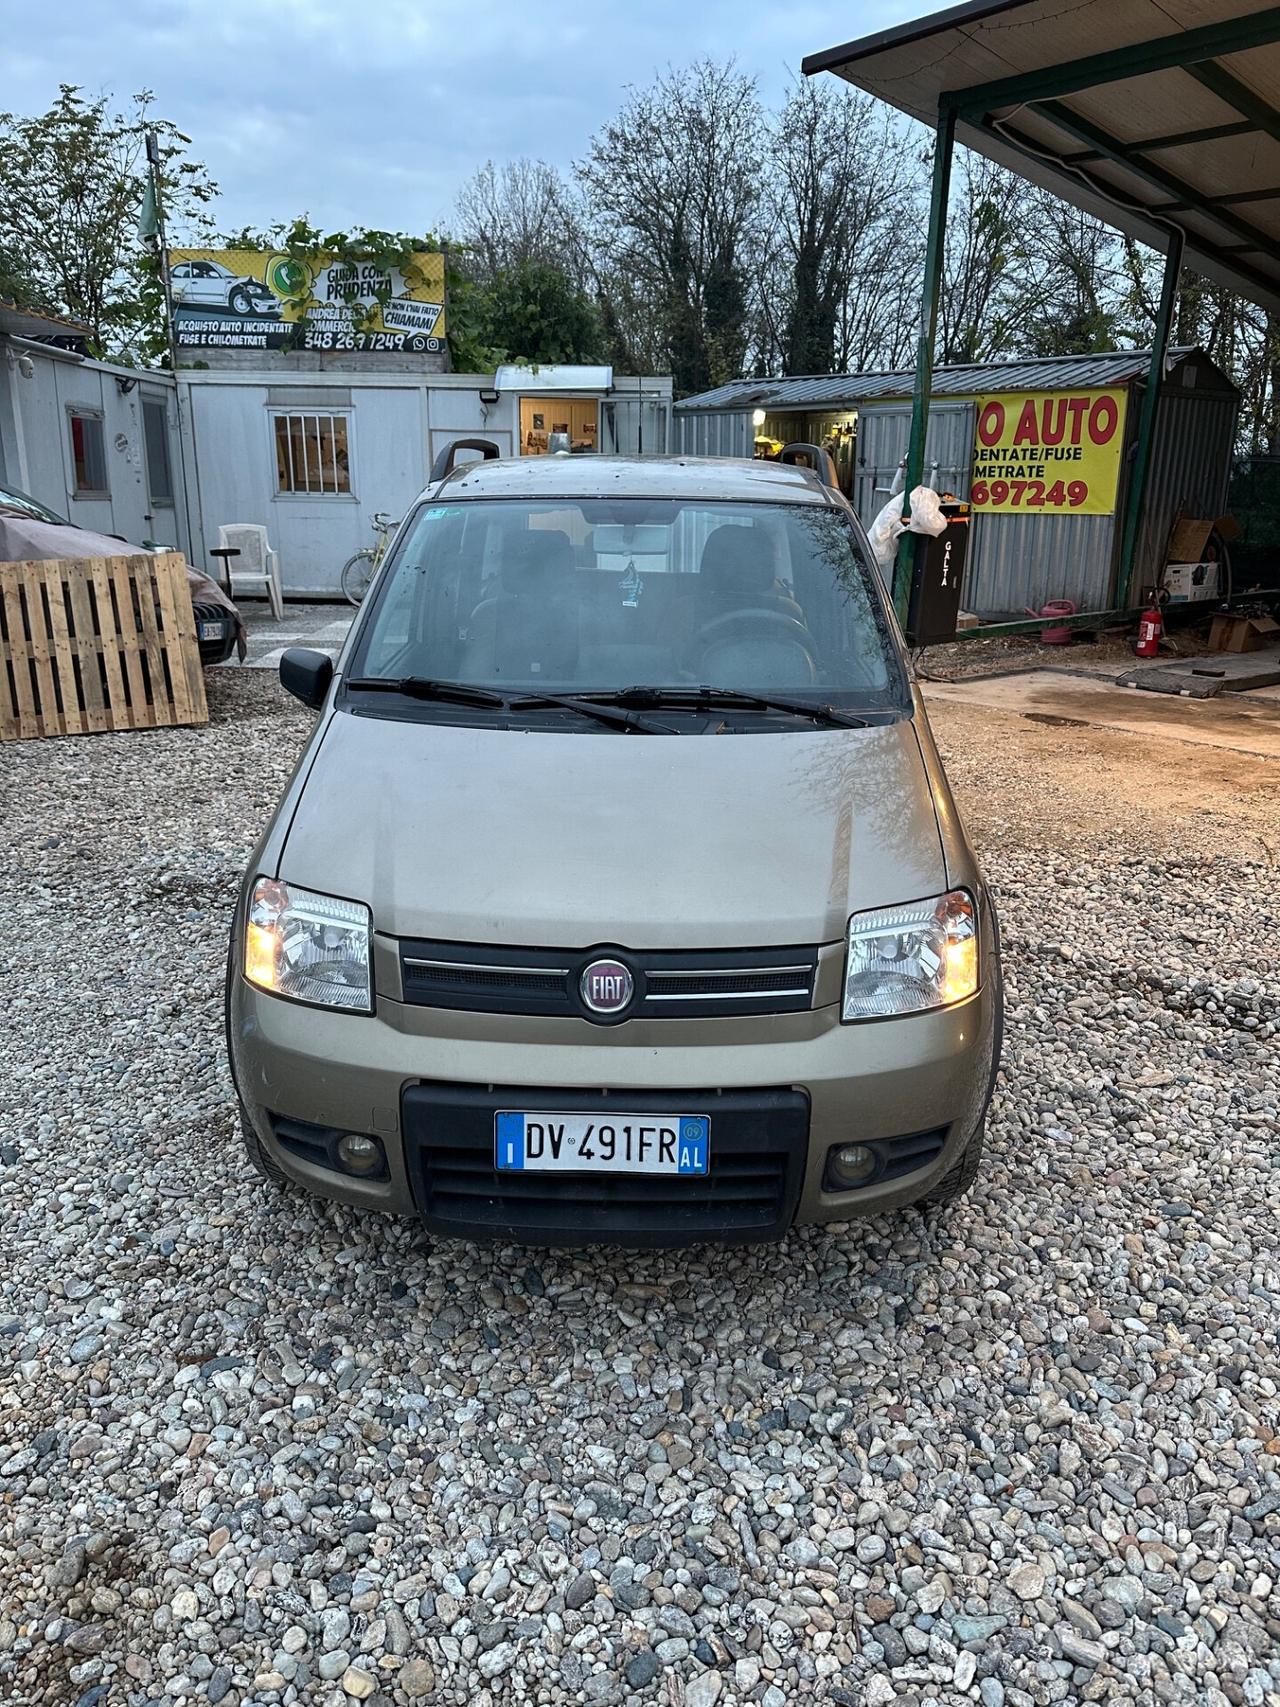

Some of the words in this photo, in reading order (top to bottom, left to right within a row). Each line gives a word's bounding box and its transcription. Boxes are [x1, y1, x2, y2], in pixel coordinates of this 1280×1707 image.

[306, 308, 340, 320] ANDREA
[421, 306, 439, 316] FATTO
[178, 320, 219, 332] ACQUISTO
[220, 321, 242, 332] AUTO
[385, 312, 434, 330] CHIAMAMI
[179, 334, 200, 344] FUSE
[201, 335, 207, 344] E
[207, 334, 267, 346] CHILOMETRATE
[304, 332, 333, 348] 348
[1013, 395, 1119, 446] AUTO
[972, 465, 1044, 478] METRATE
[971, 480, 1089, 507] 697249
[941, 541, 952, 586] GALTA
[592, 975, 623, 999] FIAT
[526, 1123, 565, 1159] DV
[577, 1124, 677, 1163] 491FR
[680, 1147, 702, 1168] AL
